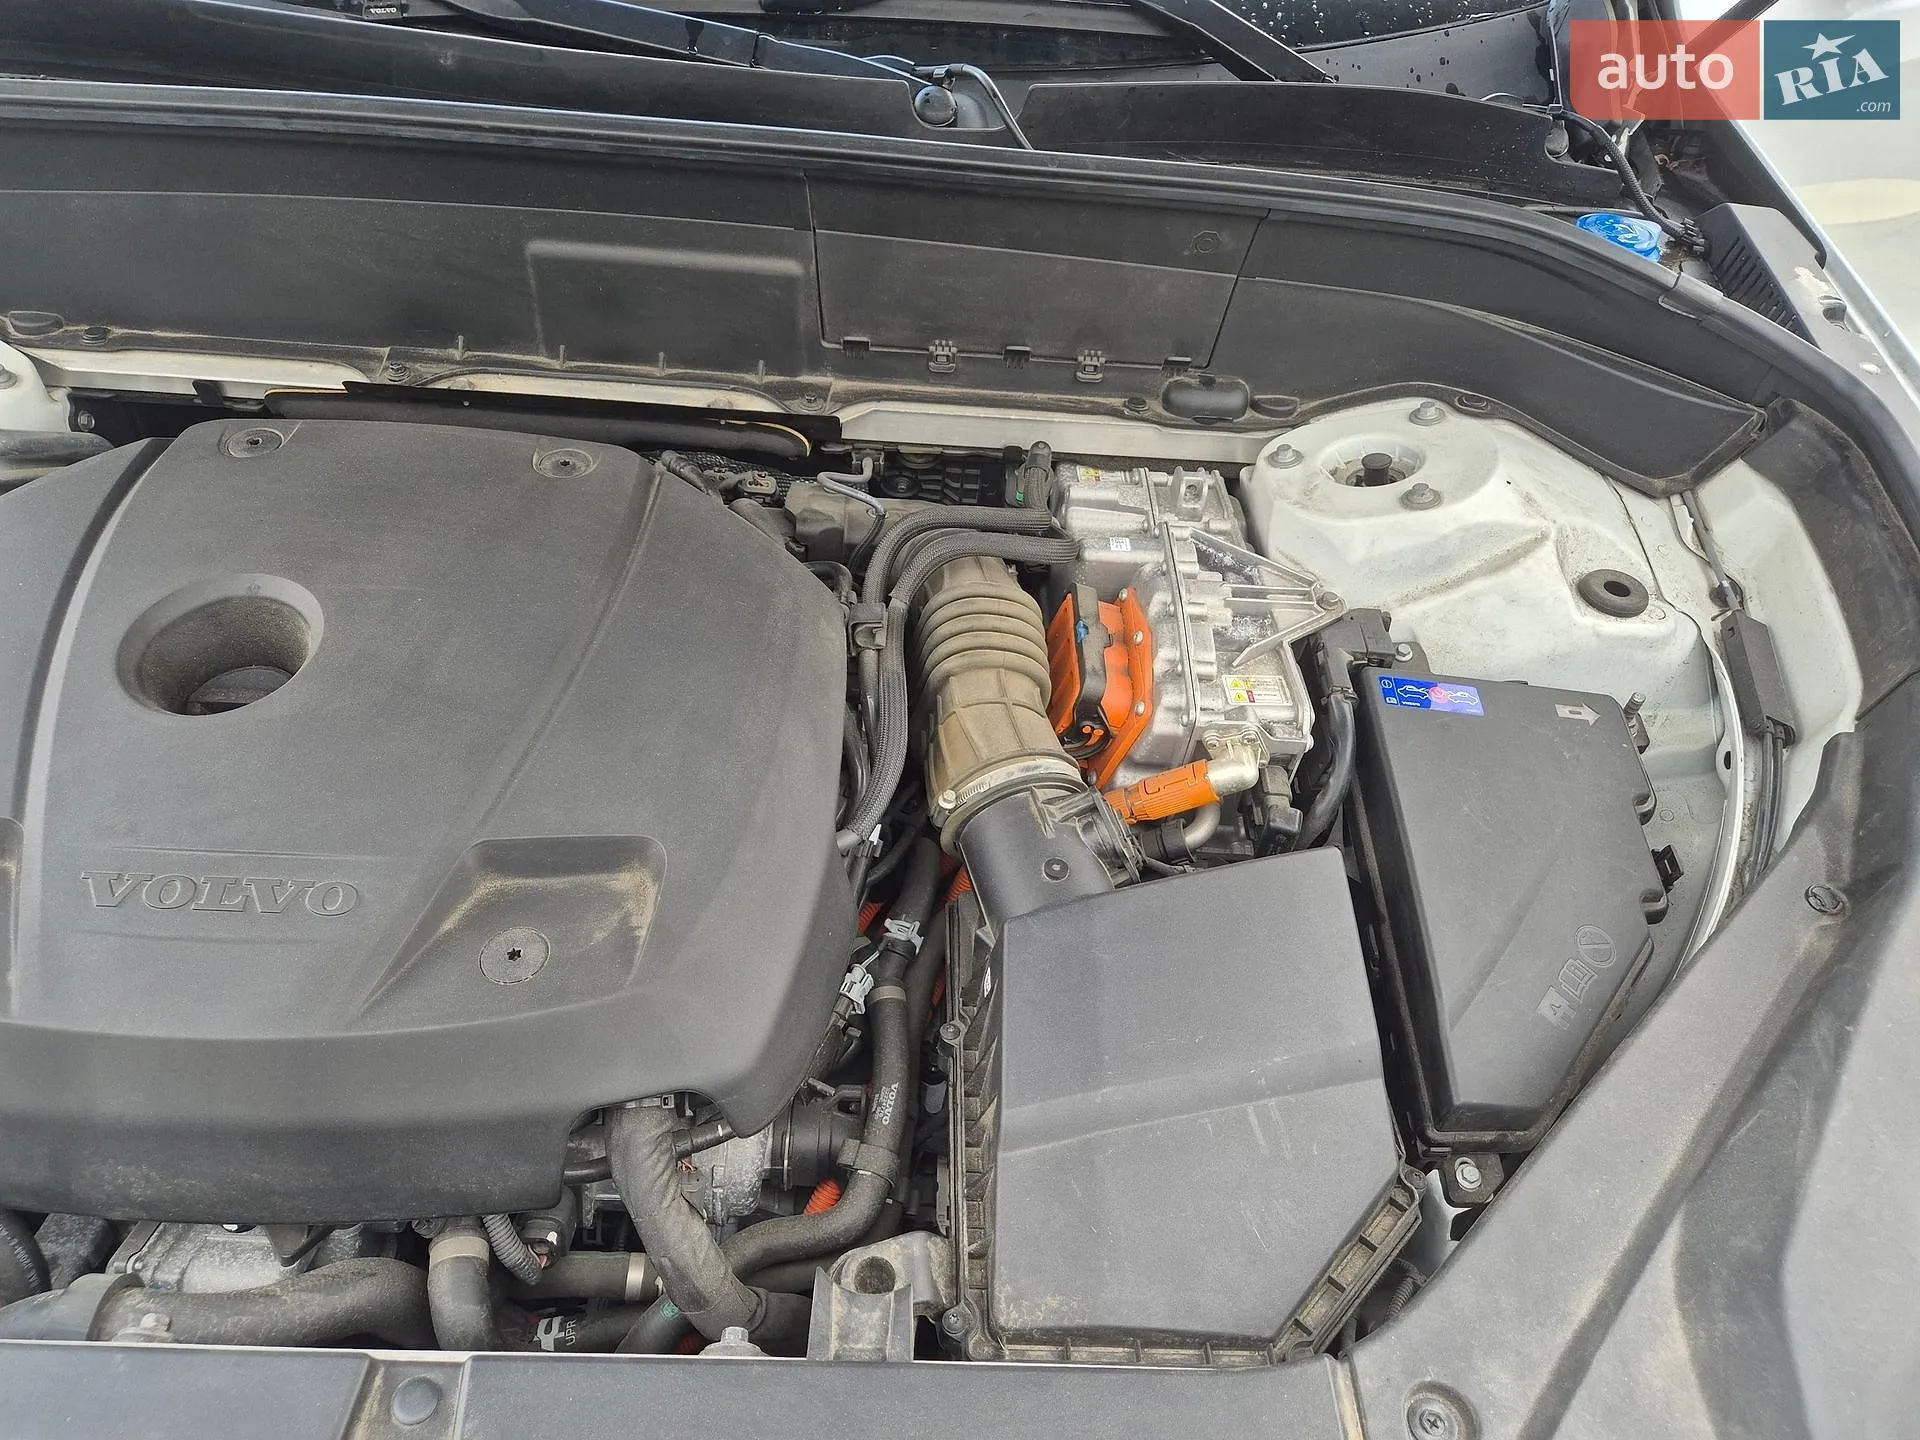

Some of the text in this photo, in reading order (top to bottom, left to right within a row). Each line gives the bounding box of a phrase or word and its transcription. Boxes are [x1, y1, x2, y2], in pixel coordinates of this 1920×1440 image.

[80, 871, 360, 917] VOLVO
[881, 1082, 899, 1126] VOLVO
[565, 1319, 577, 1346] UPR
